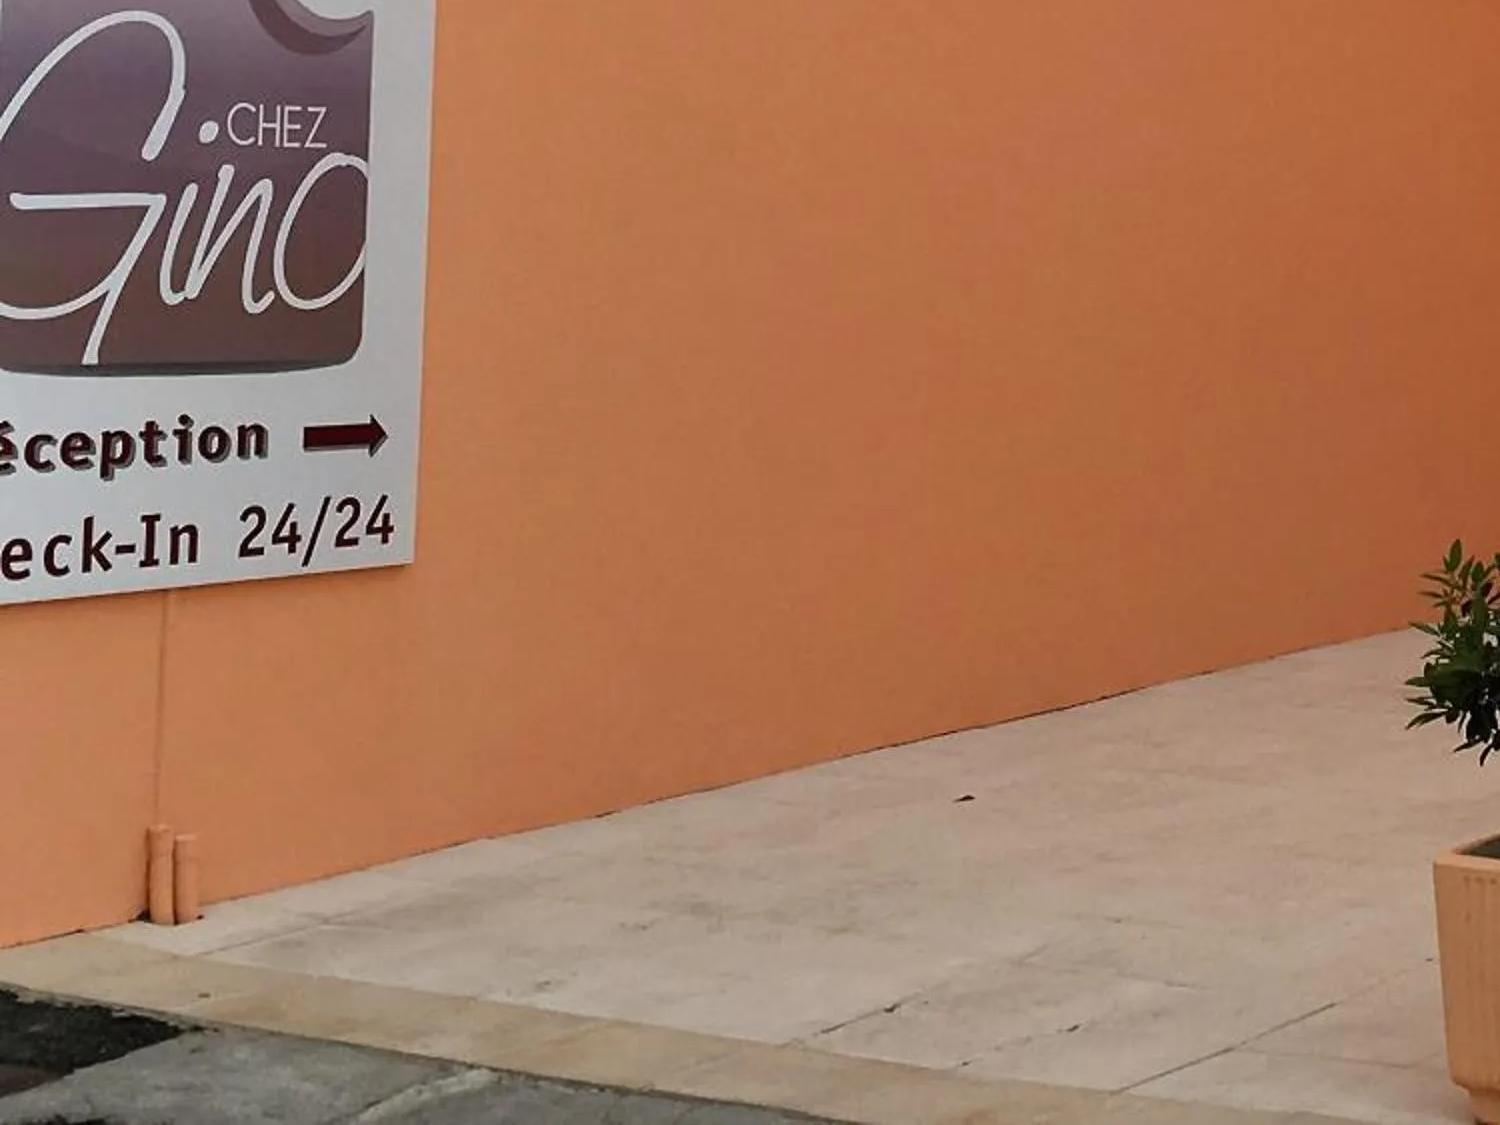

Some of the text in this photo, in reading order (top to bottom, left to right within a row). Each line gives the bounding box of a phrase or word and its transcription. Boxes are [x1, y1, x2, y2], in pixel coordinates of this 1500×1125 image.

[226, 102, 327, 149] CHEZ
[0, 9, 368, 365] Gino
[237, 494, 395, 567] 24/24
